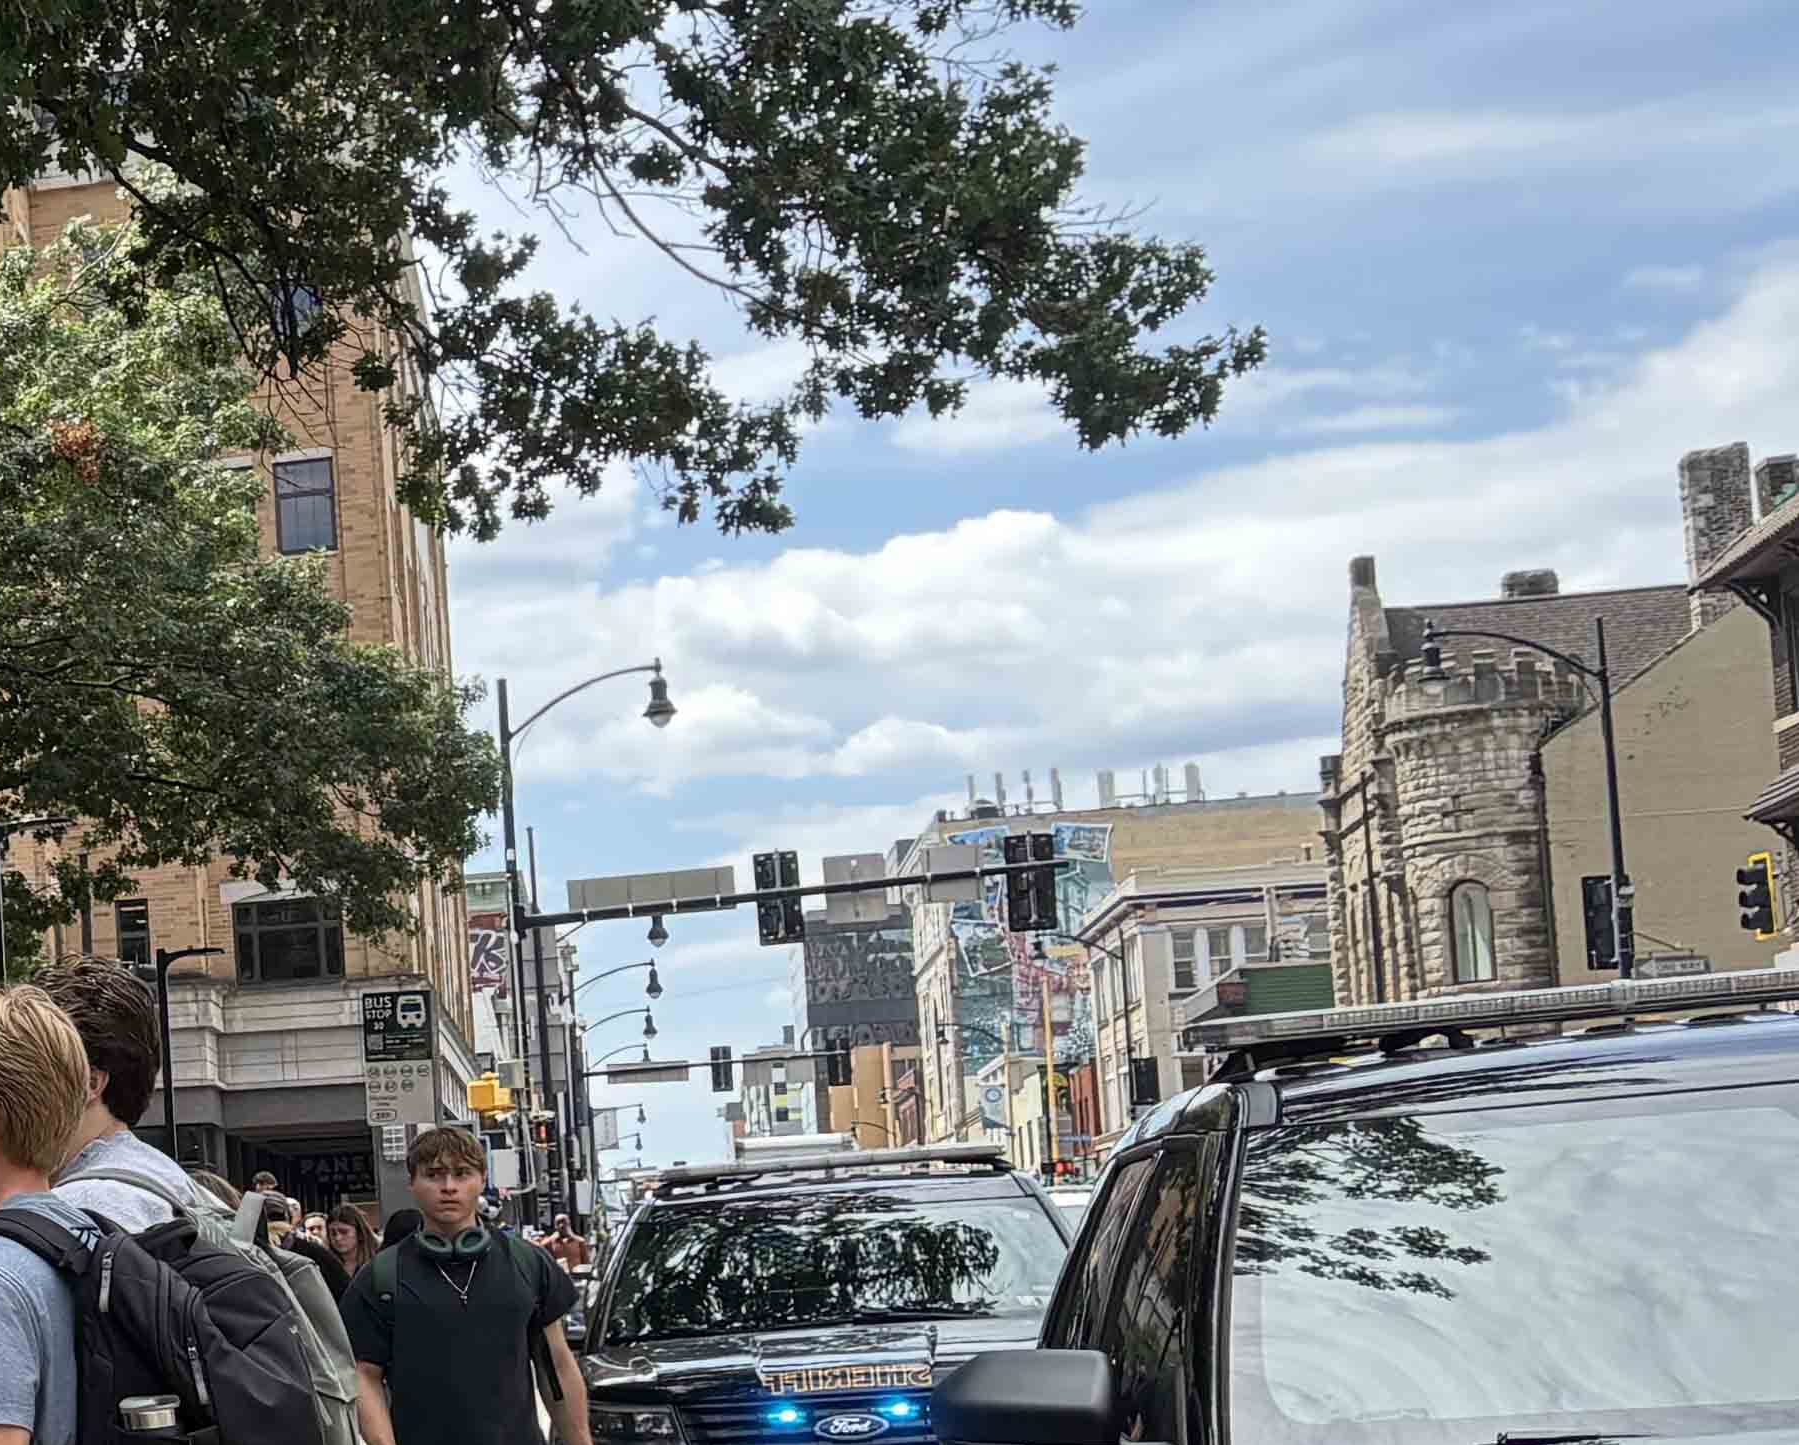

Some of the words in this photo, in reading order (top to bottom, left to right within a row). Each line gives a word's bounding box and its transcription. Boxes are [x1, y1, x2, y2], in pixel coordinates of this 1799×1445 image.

[364, 996, 393, 1009] BUS
[365, 1008, 393, 1019] STOP
[830, 1417, 872, 1434] Ford
